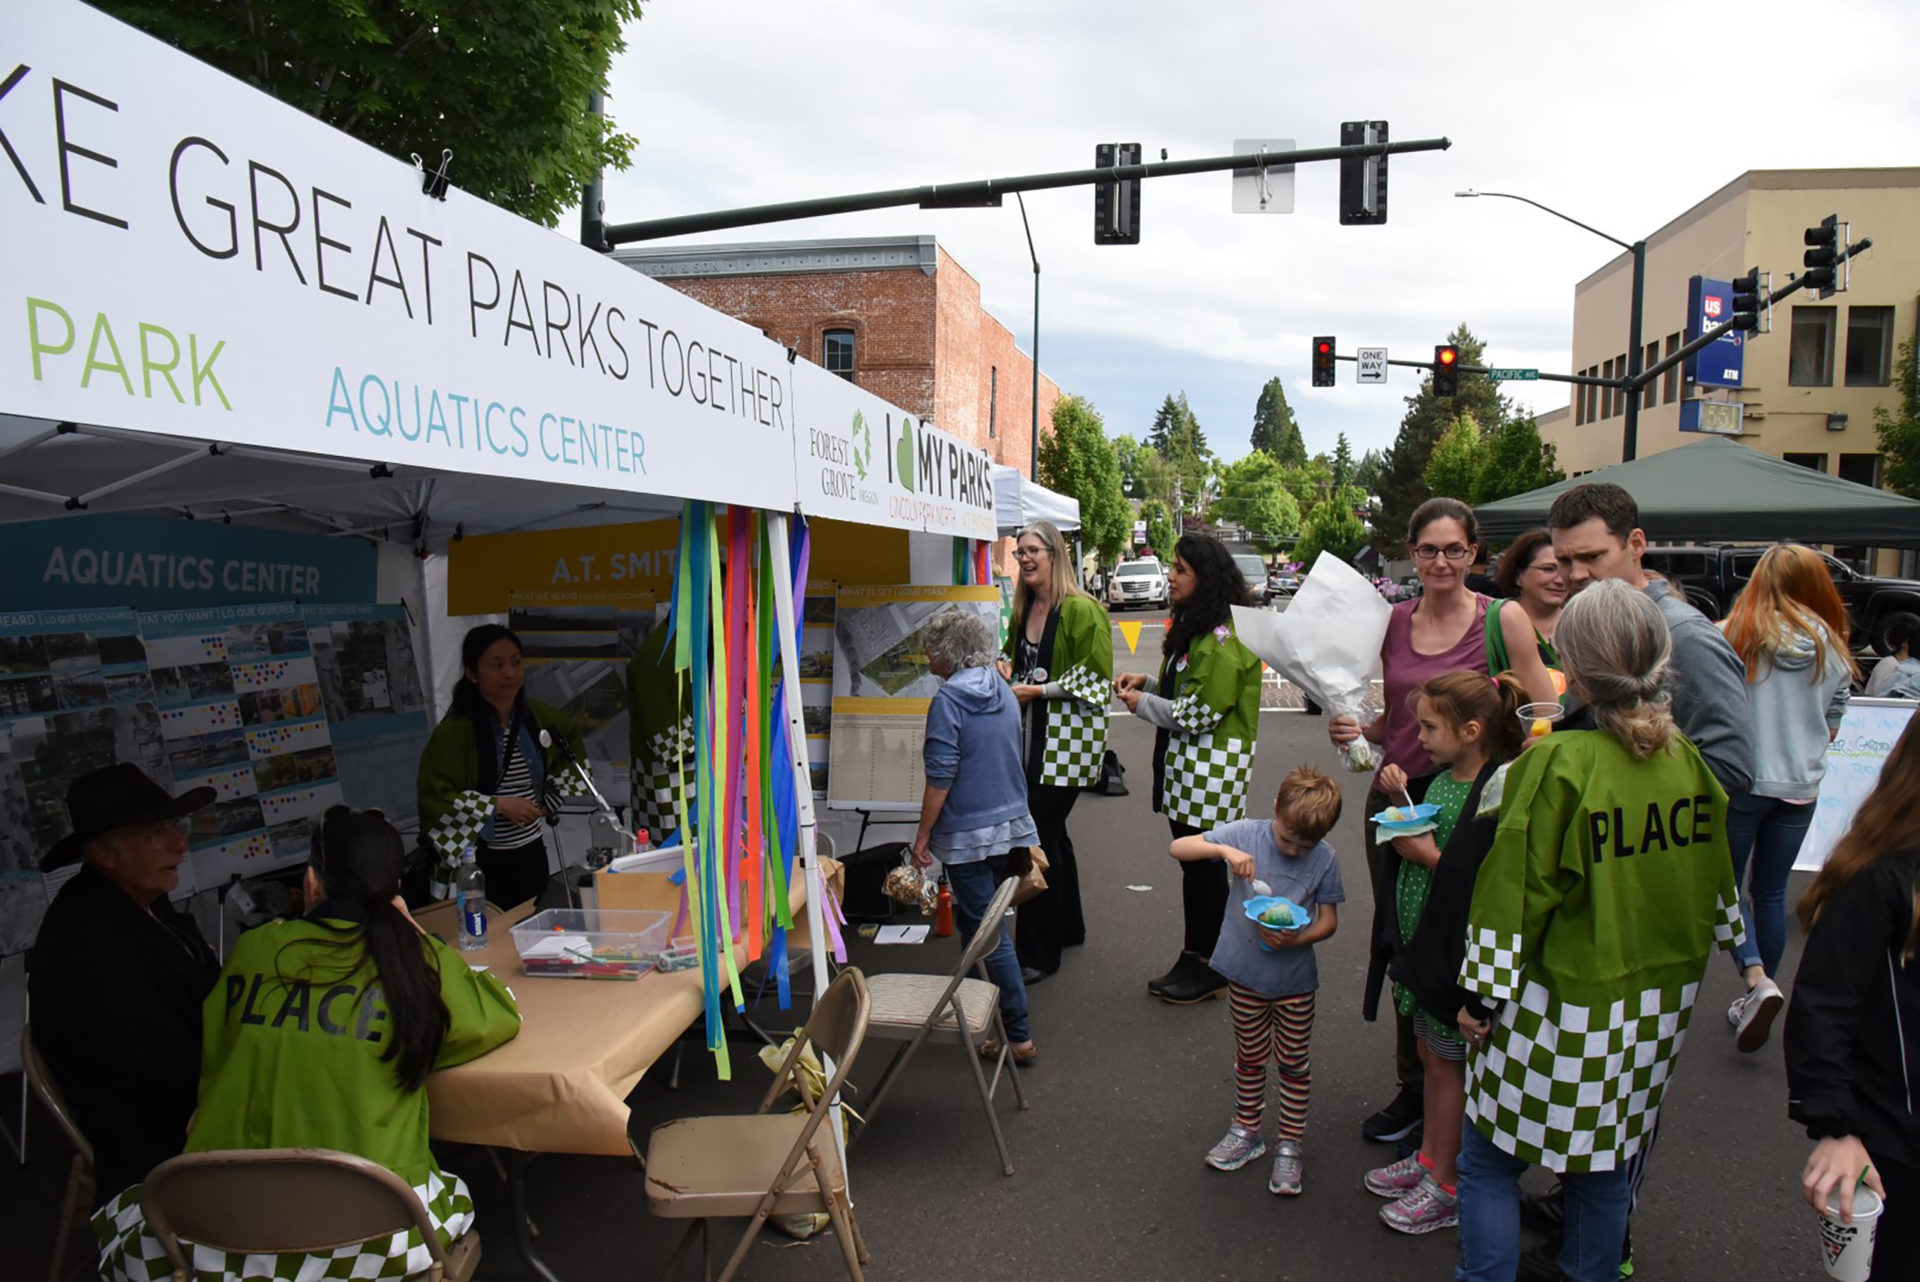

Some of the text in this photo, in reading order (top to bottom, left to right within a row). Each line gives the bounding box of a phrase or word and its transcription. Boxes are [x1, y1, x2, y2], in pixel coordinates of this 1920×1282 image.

[169, 136, 442, 326] GREAT
[467, 251, 629, 381] PARKS
[639, 318, 785, 432] TOGETHER
[1704, 300, 1721, 314] us
[25, 295, 233, 412] PARK
[1361, 361, 1383, 370] WAY
[1362, 351, 1383, 360] ONE
[1491, 370, 1523, 379] PACIFIC
[1723, 369, 1739, 381] ATM
[325, 365, 647, 475] AQUATICS CENTER
[810, 427, 849, 467] FOREST
[821, 467, 856, 501] GROVE
[917, 428, 942, 497] MY
[948, 442, 992, 511] PARKS
[42, 546, 321, 595] AQUATICS CENTER
[551, 549, 677, 585] A.T. SMIT
[58, 614, 75, 624] QUE
[161, 612, 184, 623] YOU
[186, 610, 214, 622] WANT
[237, 608, 257, 618] QUE
[1590, 795, 1713, 864] PLACE
[224, 972, 388, 1042] PLACE
